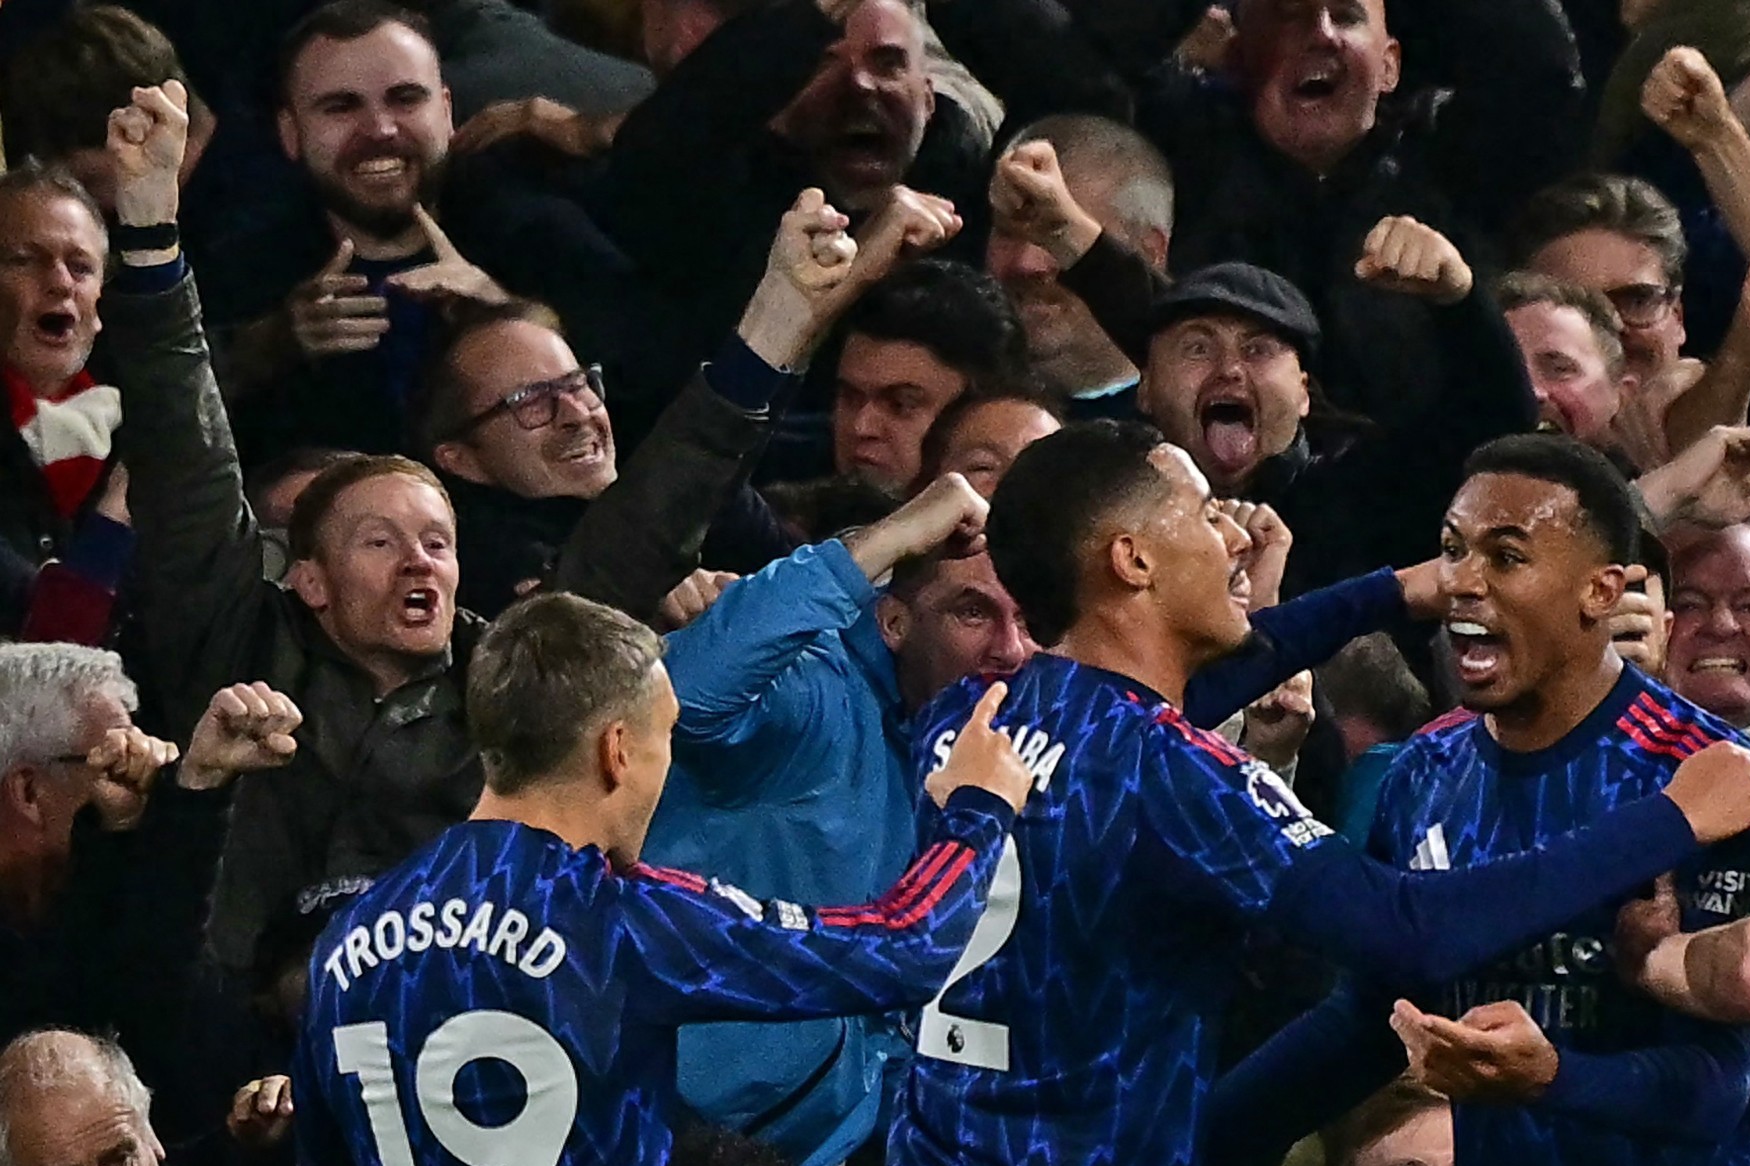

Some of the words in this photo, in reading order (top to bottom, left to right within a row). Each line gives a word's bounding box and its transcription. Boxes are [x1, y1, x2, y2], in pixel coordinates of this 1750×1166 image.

[932, 725, 1066, 793] SIBA
[324, 898, 566, 992] TROSSARD
[917, 833, 1022, 1072] 2
